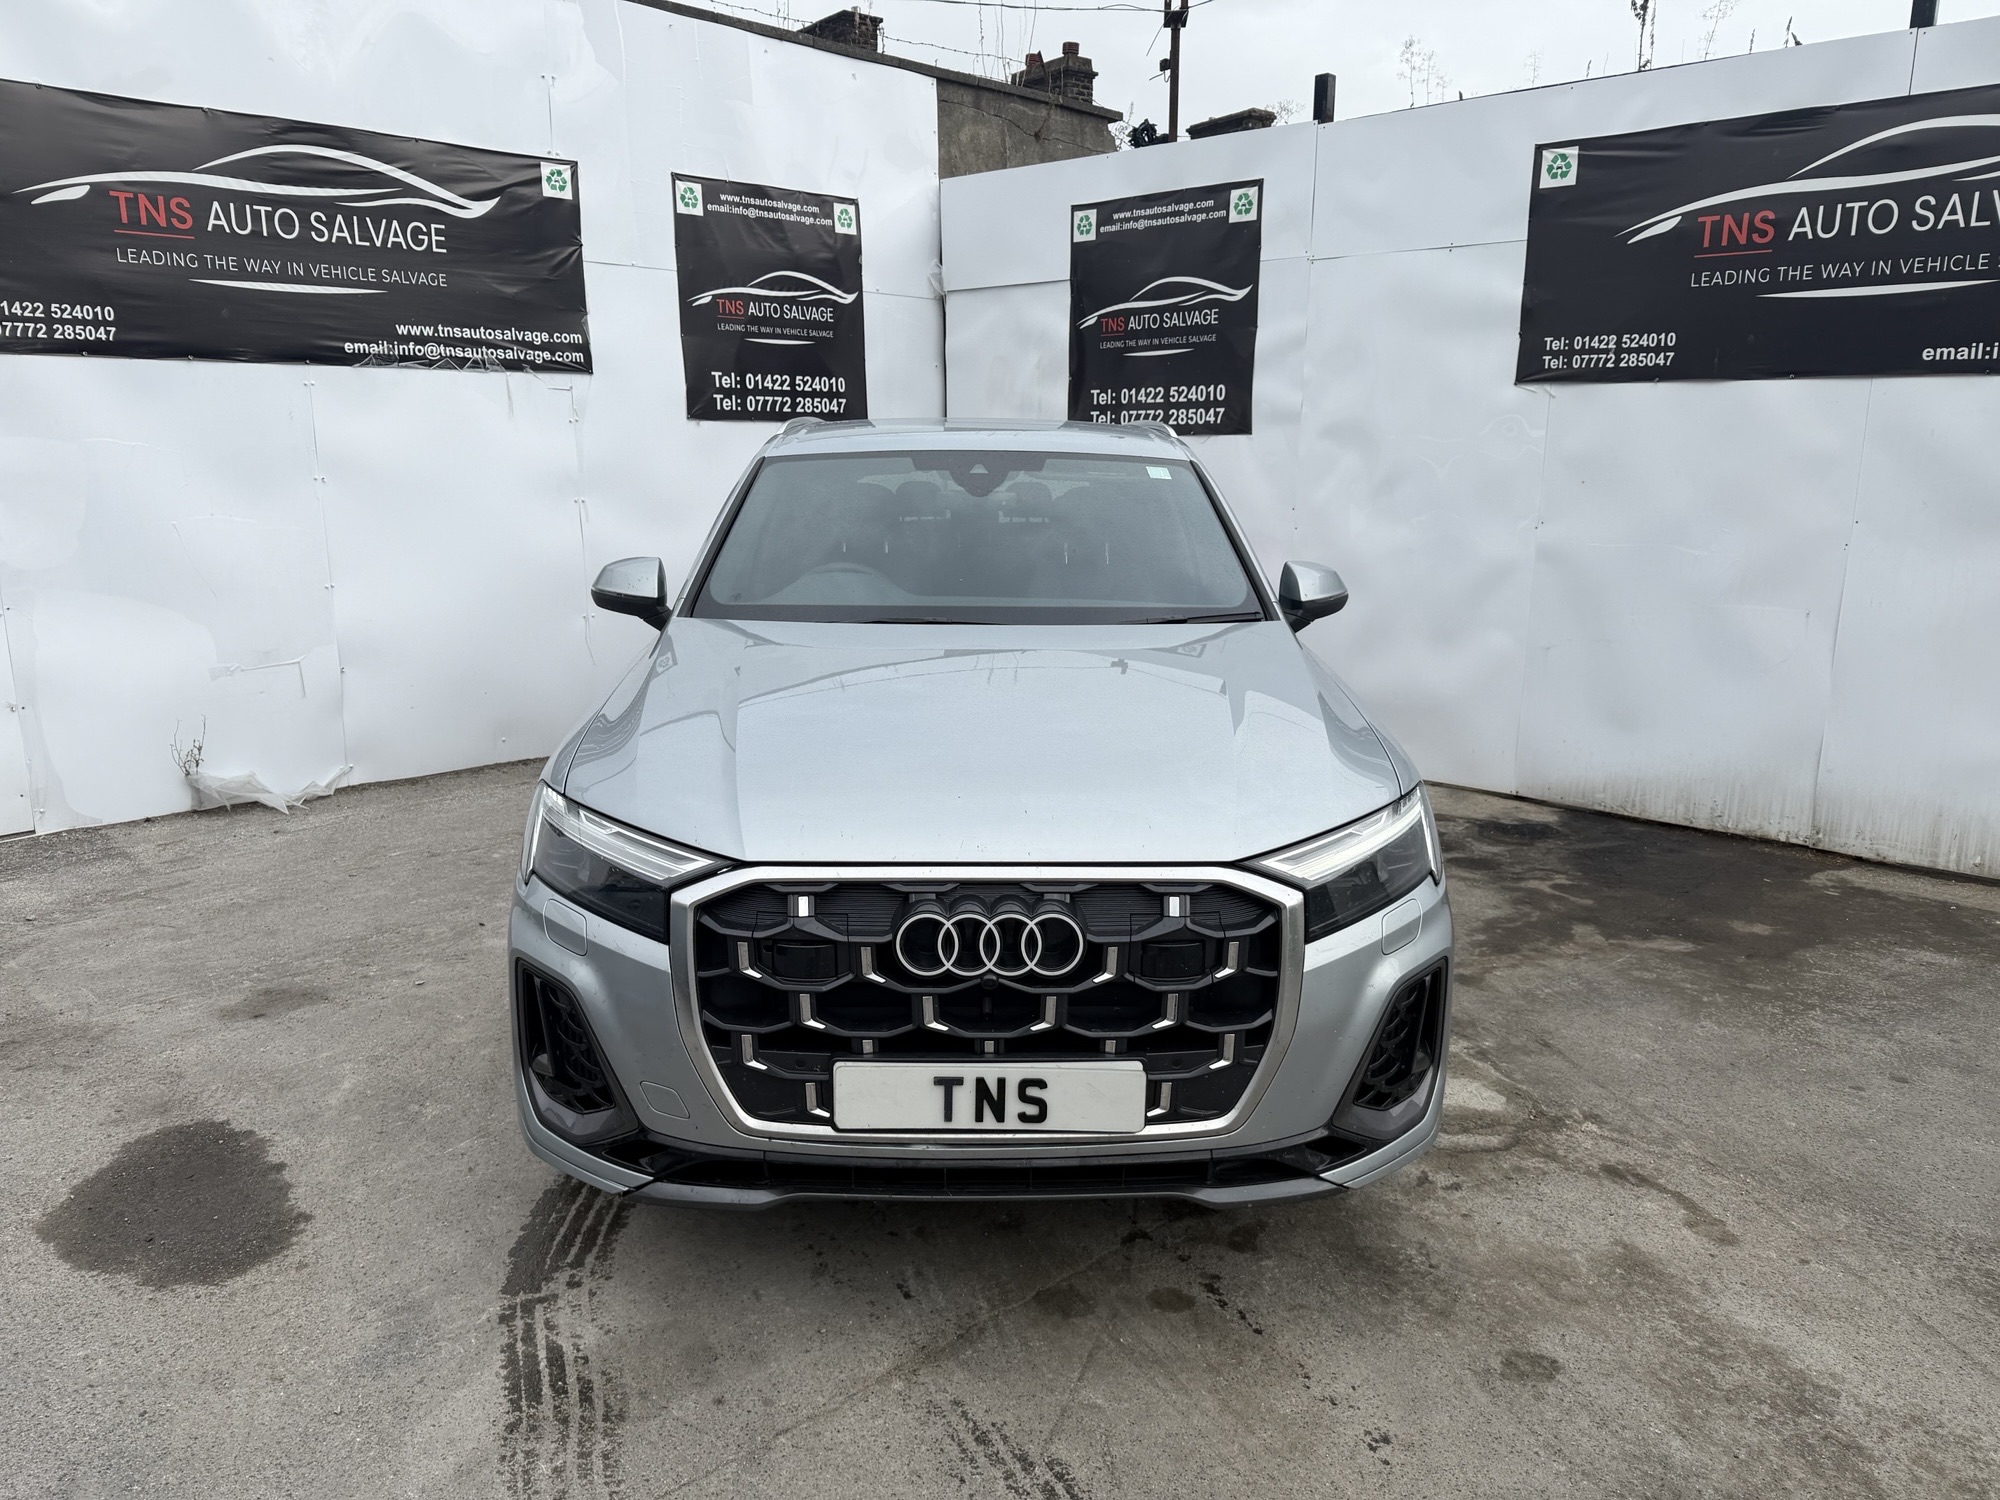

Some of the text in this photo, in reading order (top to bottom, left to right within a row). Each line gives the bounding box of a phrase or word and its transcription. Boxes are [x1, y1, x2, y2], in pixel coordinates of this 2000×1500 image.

[719, 193, 820, 214] www.tnsautosalvage.com
[1112, 200, 1214, 220] www.tnsautosalvage.com
[109, 190, 448, 253] TNS AUTO SALVAGE
[707, 203, 833, 226] email:info@tnsautosalvage.com
[1099, 210, 1227, 233] email:info@tnsautosalvage.com
[1697, 209, 1776, 248] TNS
[1787, 199, 1899, 241] AUTO
[116, 247, 448, 287] LEADING THE WAY IN VEHICLE SALVAGE
[1690, 253, 1991, 287] LEADING THE WAY IN VEHICLE
[0, 300, 115, 321] 1422 524010
[716, 298, 834, 322] TNS AUTO SALVAGE
[1100, 308, 1219, 332] TNS AUTO SALVAGE
[0, 321, 117, 341] 7772 285047
[395, 323, 583, 344] www.tnsautosalvage.com
[717, 322, 834, 338] LEADING THE WAY IN VEHICLE SALVAGE
[344, 340, 585, 363] email:info@tnsautosalvage.com
[1099, 333, 1217, 349] LEADING THE WAY IN VEHICLE SALVAGE
[1544, 332, 1677, 350] Tel: 01422 524010
[1542, 352, 1675, 369] Tel: 07772 285047
[711, 371, 846, 393] Tel: 01422 524010
[713, 394, 847, 413] Tel: 07772 285047
[1090, 384, 1226, 405] Tel: 01422 524010
[1090, 411, 1116, 425] Tel:
[1168, 407, 1225, 425] 285047
[933, 1076, 1048, 1124] TNS
